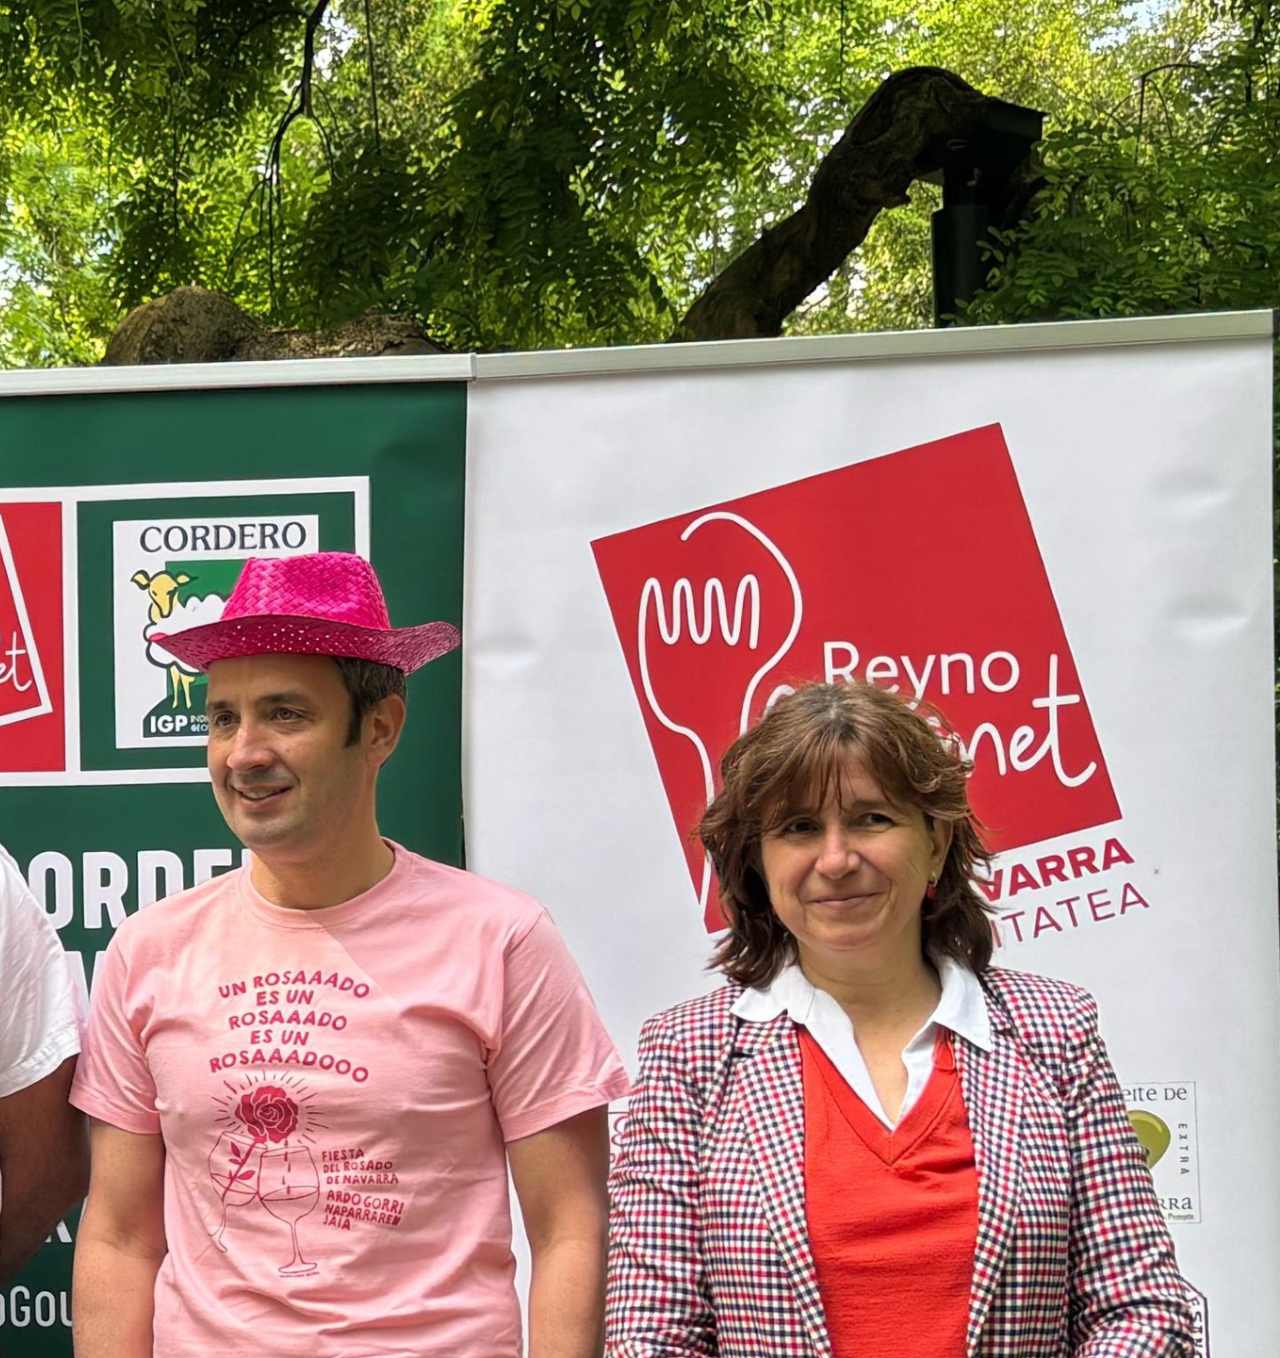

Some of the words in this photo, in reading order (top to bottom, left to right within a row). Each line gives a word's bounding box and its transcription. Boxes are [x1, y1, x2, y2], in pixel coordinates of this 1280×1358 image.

[140, 522, 307, 553] CORDERO
[823, 641, 1020, 711] Reyno
[150, 715, 189, 734] IGP
[979, 837, 1135, 903] VARRA
[991, 882, 1150, 948] ITATEA
[218, 981, 247, 999] UN
[253, 970, 370, 999] ROSAAADO
[256, 990, 279, 1006] ES
[286, 989, 314, 1005] UN
[228, 1010, 348, 1031] ROSAAADO
[250, 1029, 273, 1045] ES
[281, 1030, 310, 1046] UN
[209, 1048, 369, 1082] ROSAAADOOO
[322, 1148, 365, 1161] FIESTA
[323, 1163, 340, 1173] DEL
[343, 1160, 393, 1171] ROSADO
[326, 1176, 340, 1185] DE
[342, 1174, 399, 1185] NAVARRA
[326, 1189, 361, 1206] ARDO
[363, 1195, 404, 1215] GORRI
[322, 1214, 351, 1231] JAIA
